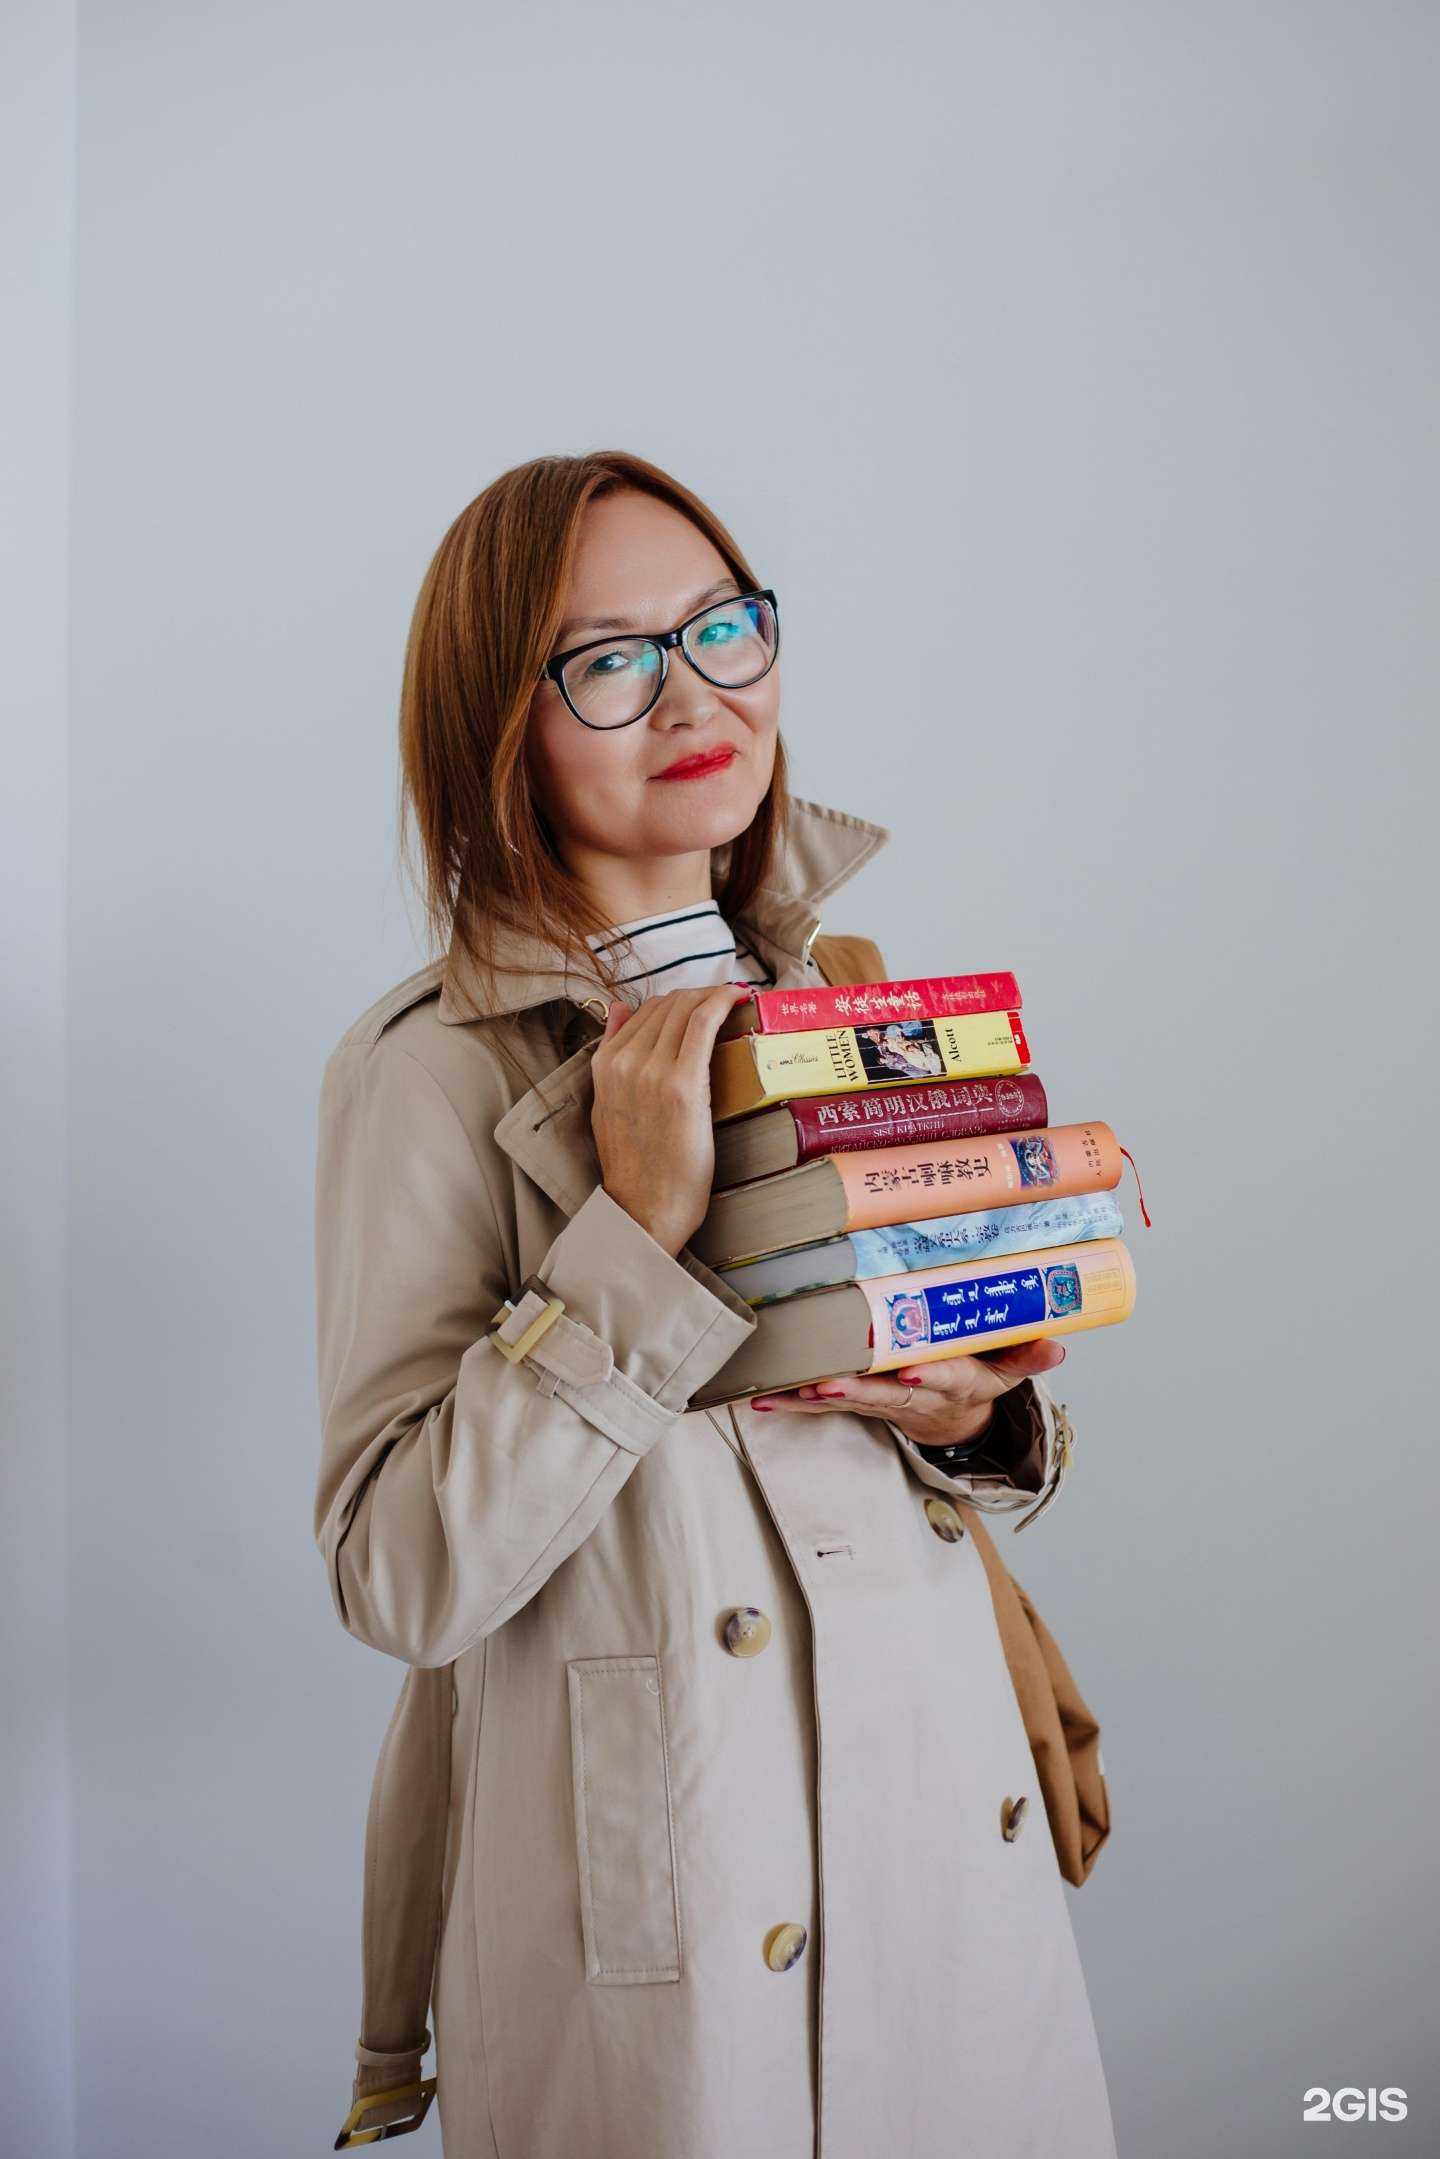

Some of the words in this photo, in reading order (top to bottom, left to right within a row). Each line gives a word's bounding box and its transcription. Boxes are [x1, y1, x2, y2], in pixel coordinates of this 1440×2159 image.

[834, 990, 923, 1018] 安徒生童话
[826, 1034, 845, 1080] LITTLE
[840, 1029, 859, 1082] WOMEN
[945, 1027, 962, 1062] Alcott
[817, 1083, 994, 1126] 西索简明汉俄词典
[864, 1155, 993, 1194] 内蒙古喇嘛教史
